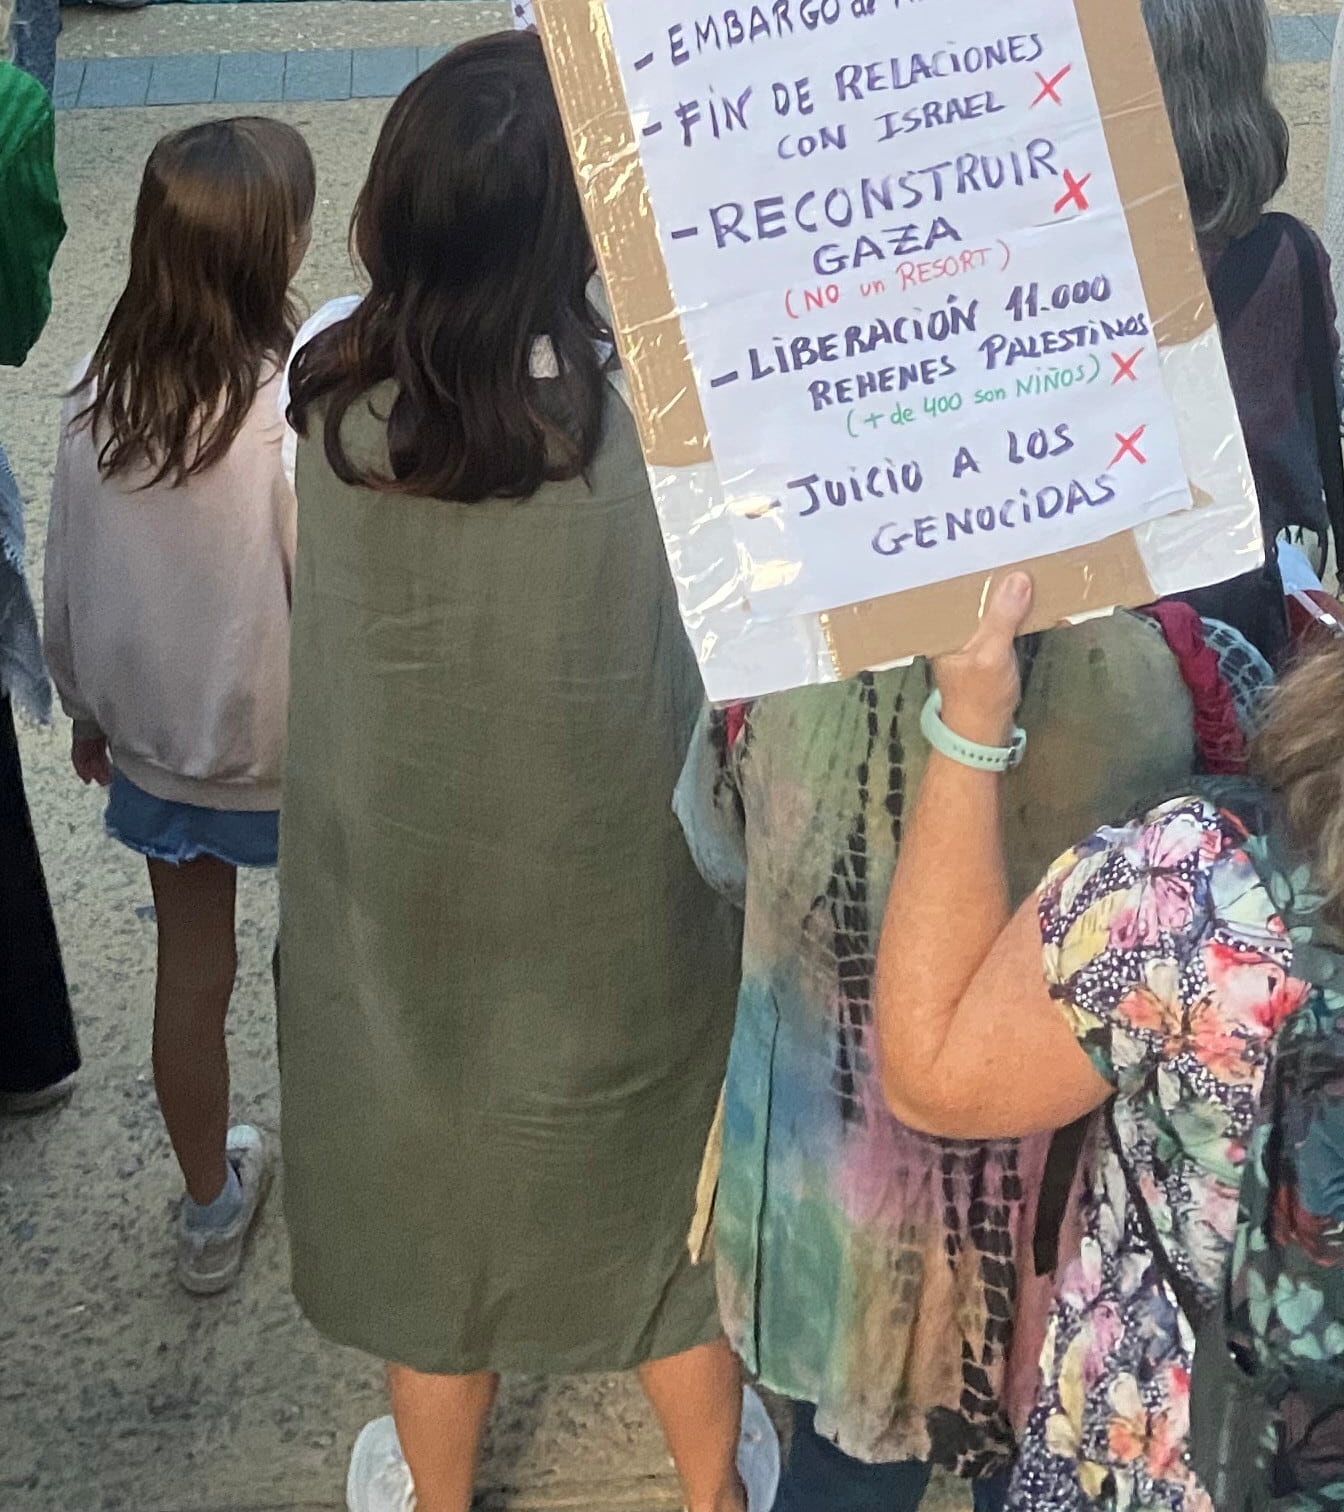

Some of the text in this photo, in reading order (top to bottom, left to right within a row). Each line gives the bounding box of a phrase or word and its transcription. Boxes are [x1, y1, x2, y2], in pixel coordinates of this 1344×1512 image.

[772, 76, 814, 117] DE
[777, 90, 1006, 160] CON ISRAEL
[708, 138, 1059, 249] RECONSTRUIR
[813, 215, 962, 276] GAZA
[861, 278, 885, 298] un
[1005, 274, 1112, 322] 11.000
[808, 354, 956, 411] REHENES
[890, 400, 914, 426] de
[923, 392, 962, 419] 400
[974, 385, 1006, 406] son
[952, 445, 981, 479] A
[1007, 422, 1075, 465] LOS
